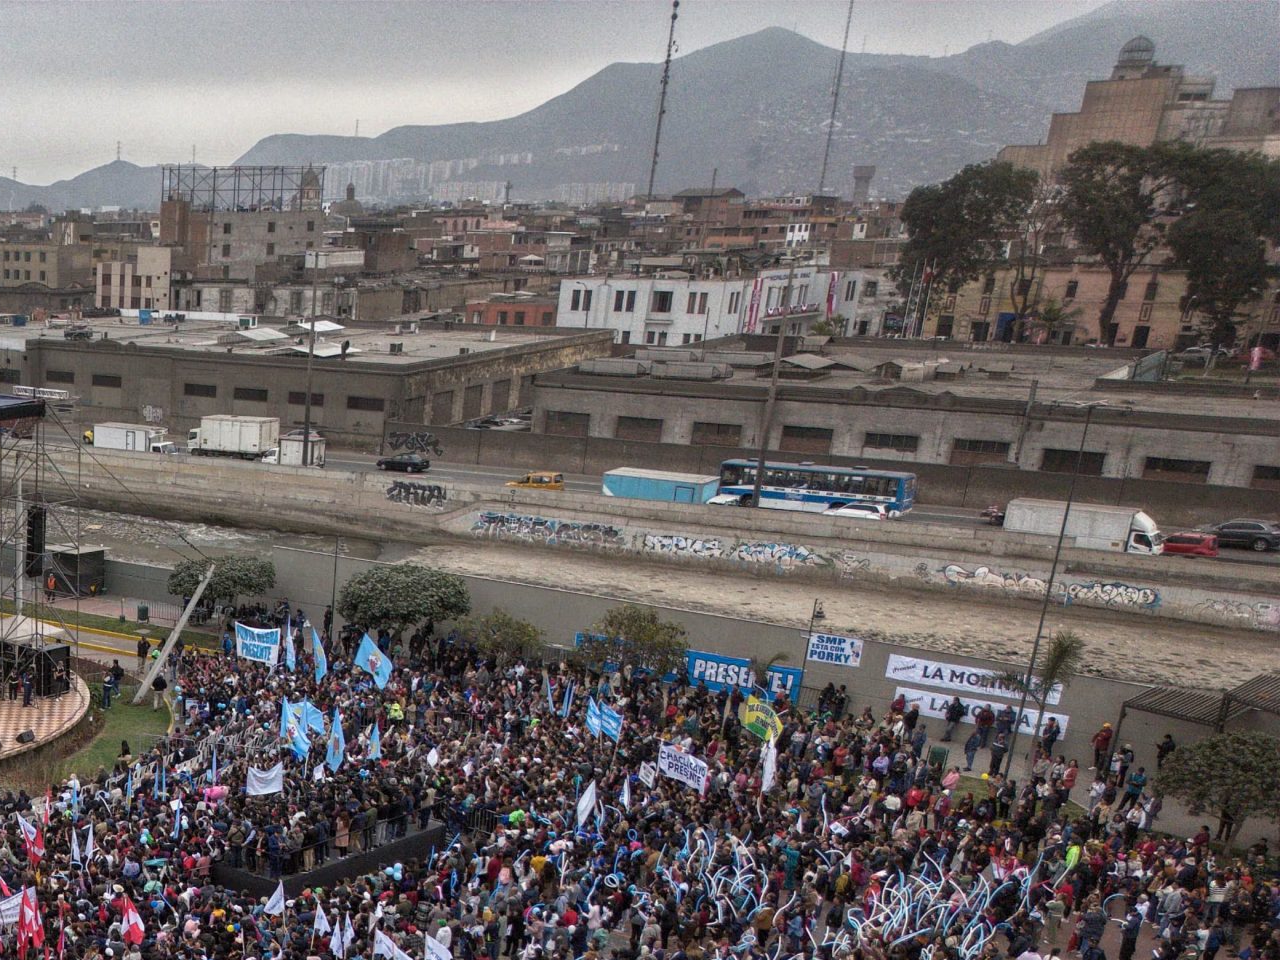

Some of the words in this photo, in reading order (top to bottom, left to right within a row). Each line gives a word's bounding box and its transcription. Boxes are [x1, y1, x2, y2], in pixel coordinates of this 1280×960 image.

[816, 635, 847, 646] SMP
[809, 649, 850, 663] PORKY
[829, 645, 845, 653] CON
[922, 665, 944, 681] LA
[929, 697, 950, 712] LA
